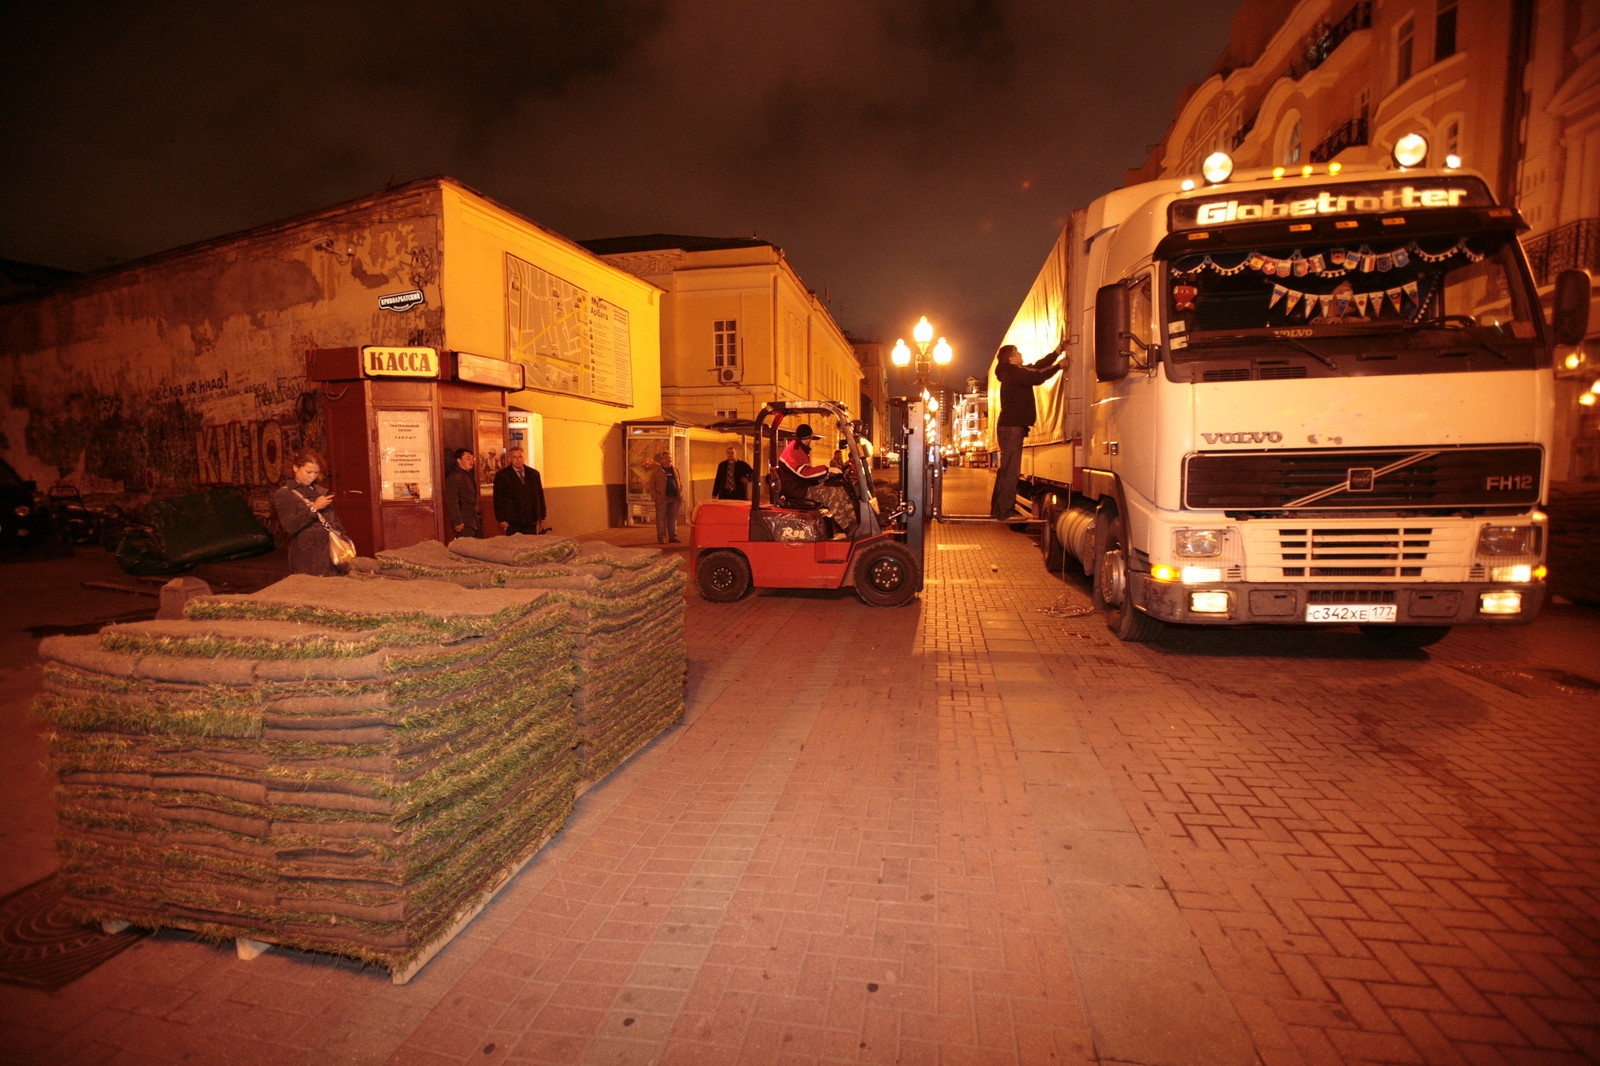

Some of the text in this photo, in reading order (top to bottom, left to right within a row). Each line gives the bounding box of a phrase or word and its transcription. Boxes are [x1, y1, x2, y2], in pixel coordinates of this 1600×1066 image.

[1196, 187, 1467, 225] Globetrotter
[369, 352, 432, 372] КАССА
[1201, 431, 1283, 444] VOLVO
[1486, 475, 1532, 490] FH12
[1372, 606, 1393, 617] 177
